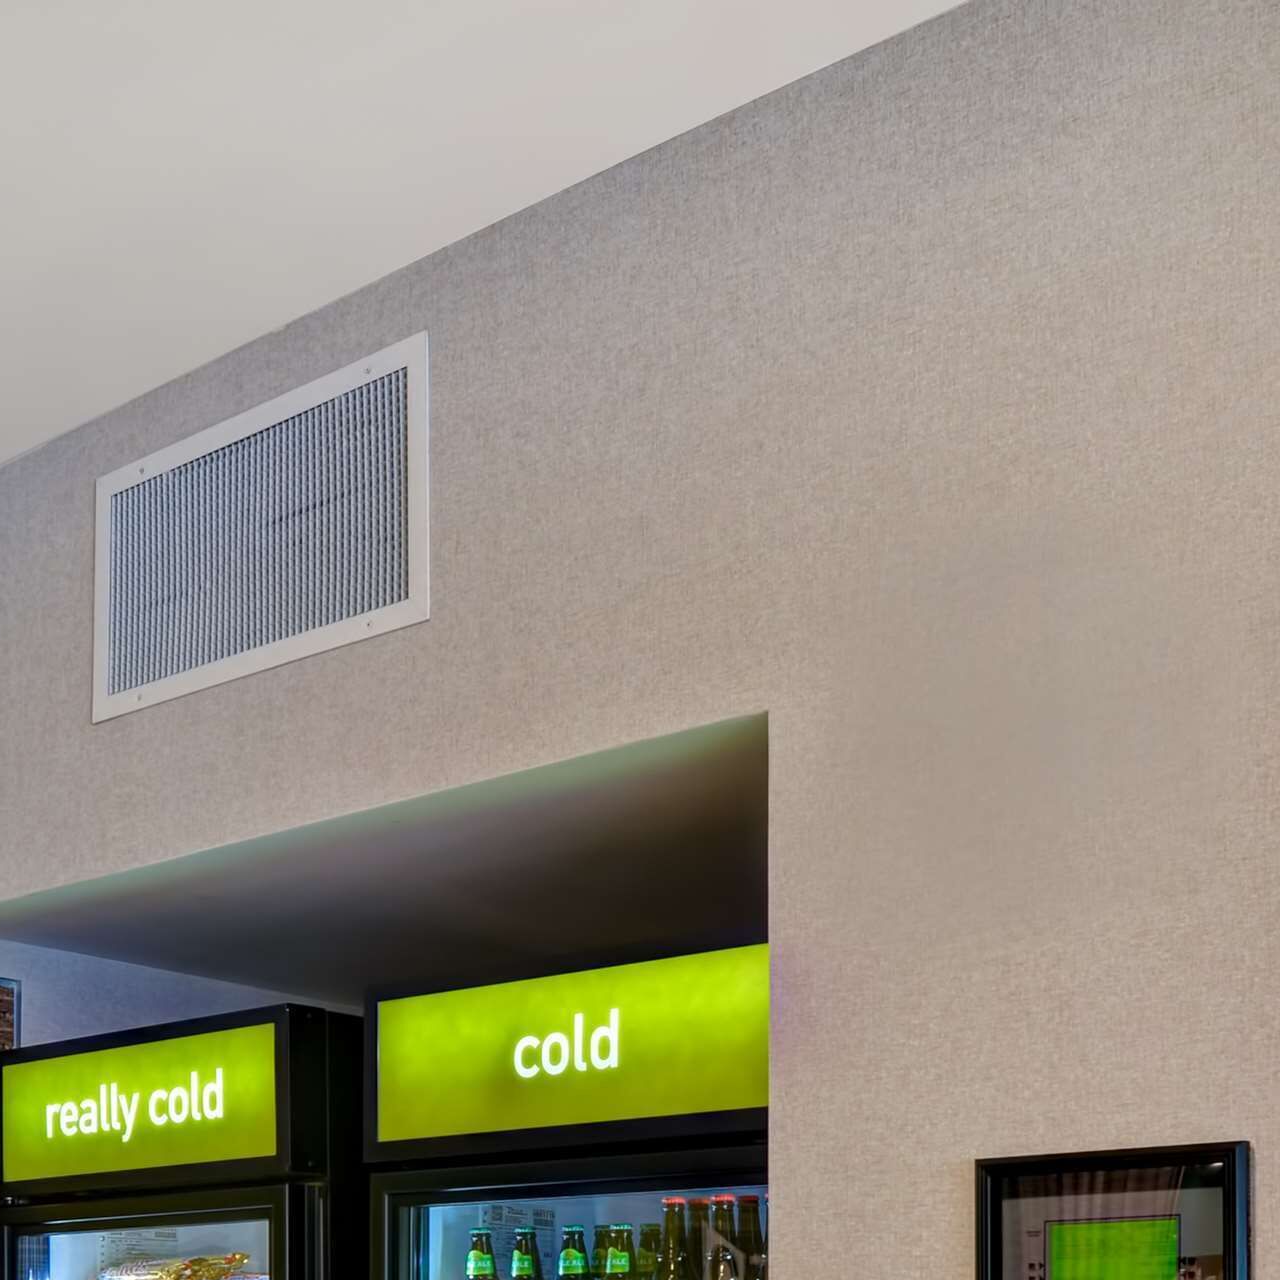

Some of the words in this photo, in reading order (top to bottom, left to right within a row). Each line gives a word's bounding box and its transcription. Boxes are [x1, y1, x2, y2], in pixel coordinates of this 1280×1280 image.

[514, 1007, 620, 1078] cold
[46, 1083, 139, 1141] really
[149, 1068, 224, 1125] cold
